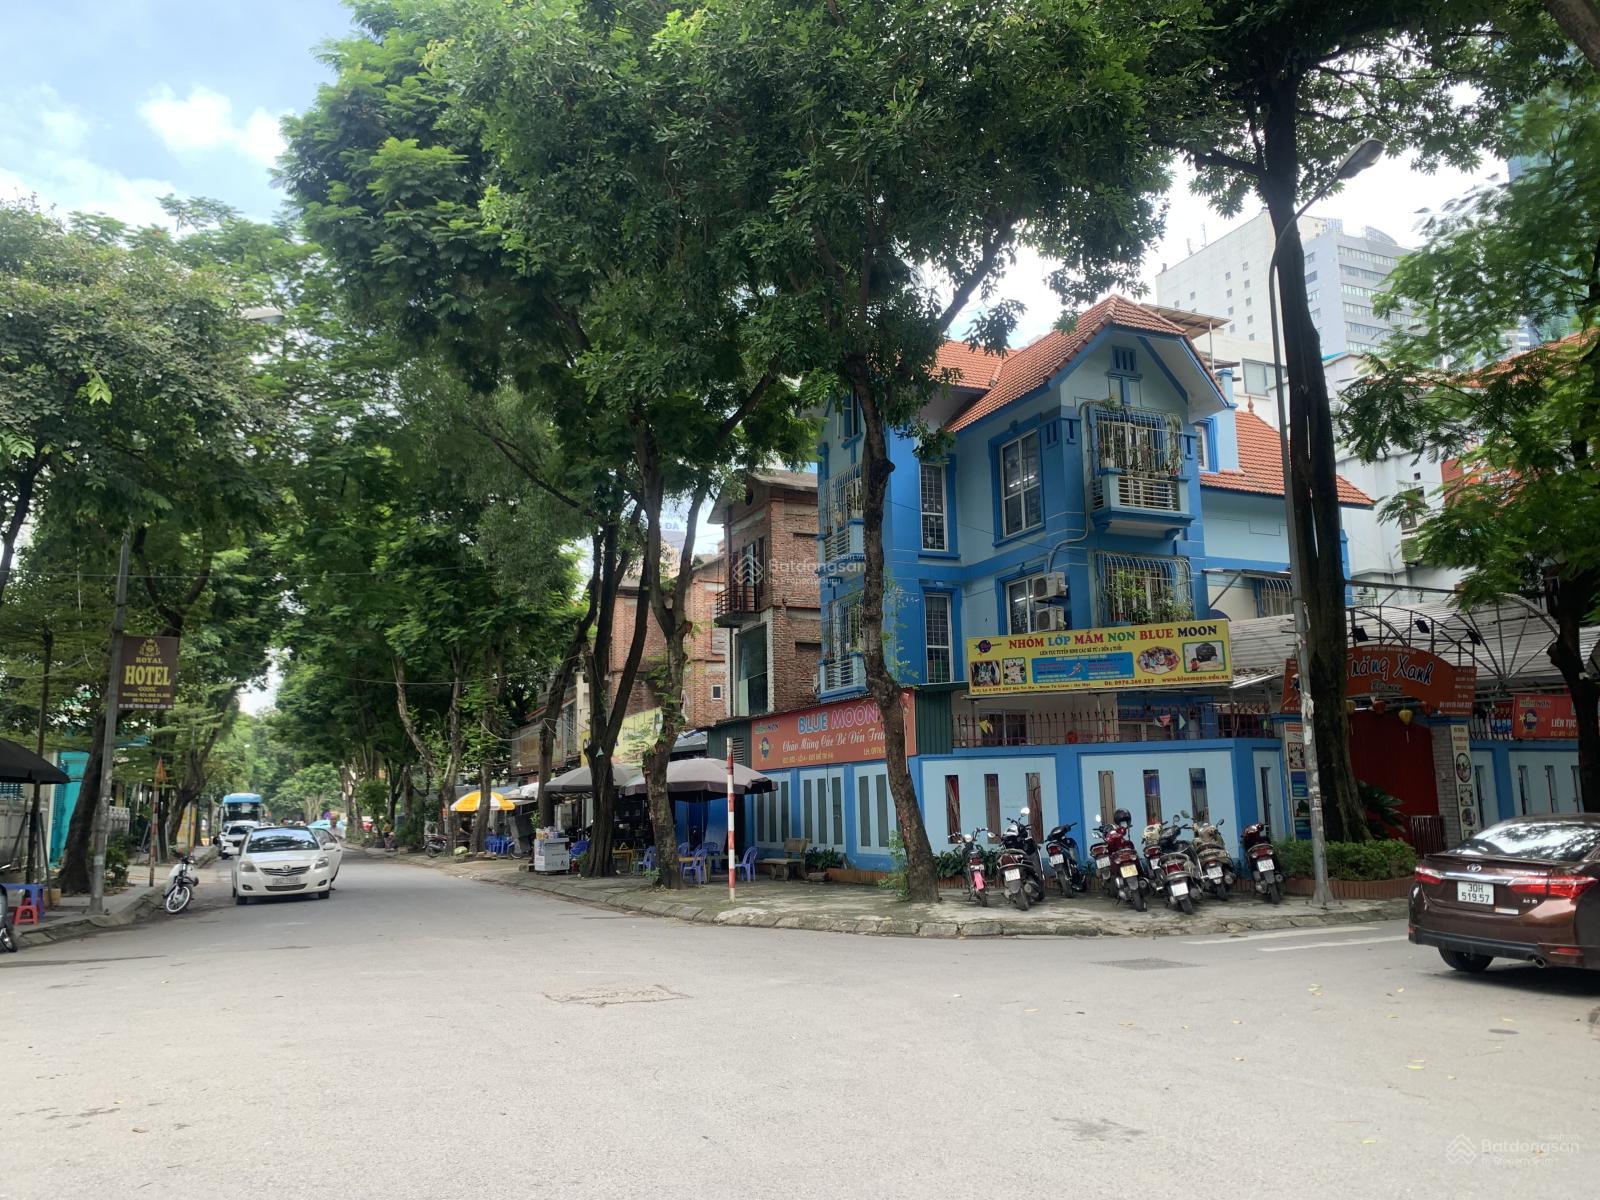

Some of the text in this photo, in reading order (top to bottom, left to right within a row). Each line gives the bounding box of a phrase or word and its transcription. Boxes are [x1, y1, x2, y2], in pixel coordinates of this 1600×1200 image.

[1009, 636, 1044, 649] NHÓM
[1108, 631, 1136, 643] NON
[1139, 629, 1174, 641] BLUE
[1177, 625, 1217, 637] MOON
[124, 665, 171, 686] HOTEL
[1393, 654, 1434, 686] Xanh
[797, 703, 880, 735] BLUE MOON
[1461, 891, 1490, 902] 519.57
[1467, 883, 1484, 893] 30H
